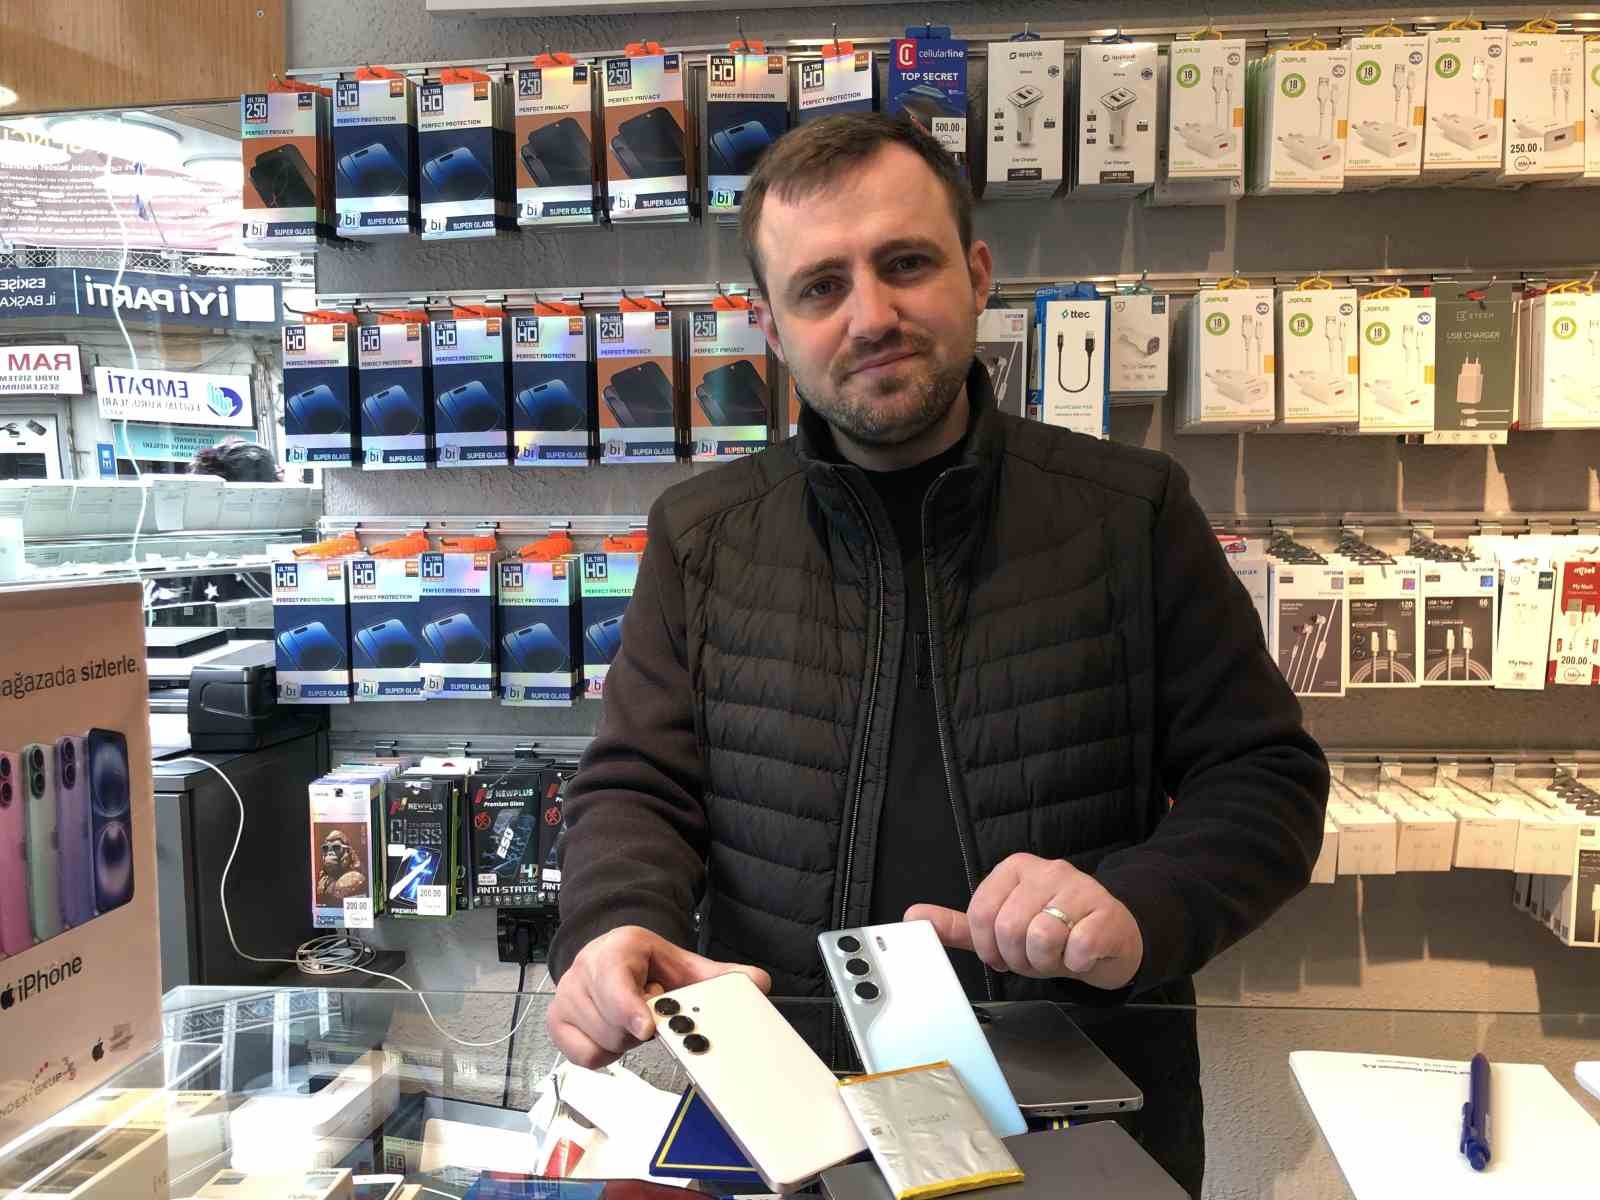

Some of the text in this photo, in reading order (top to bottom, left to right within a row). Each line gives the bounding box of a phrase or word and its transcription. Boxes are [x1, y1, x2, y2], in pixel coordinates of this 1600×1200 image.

[918, 48, 964, 58] cellularline
[1443, 60, 1452, 70] 18
[901, 72, 958, 81] TOP SECRET
[1364, 67, 1373, 77] 18
[1290, 79, 1298, 89] 18
[935, 122, 960, 132] 500.00
[1511, 143, 1537, 154] 250.00
[1070, 310, 1090, 319] ttec
[1561, 656, 1587, 664] 200.00
[0, 656, 140, 699] ağazada sizlerle.
[495, 789, 534, 798] NEWPLUS
[408, 803, 443, 811] NEWPLUS
[497, 828, 514, 859] ESD
[477, 886, 538, 895] ANTI-STATIC
[346, 902, 367, 911] 200.00
[18, 955, 83, 1003] iPhone
